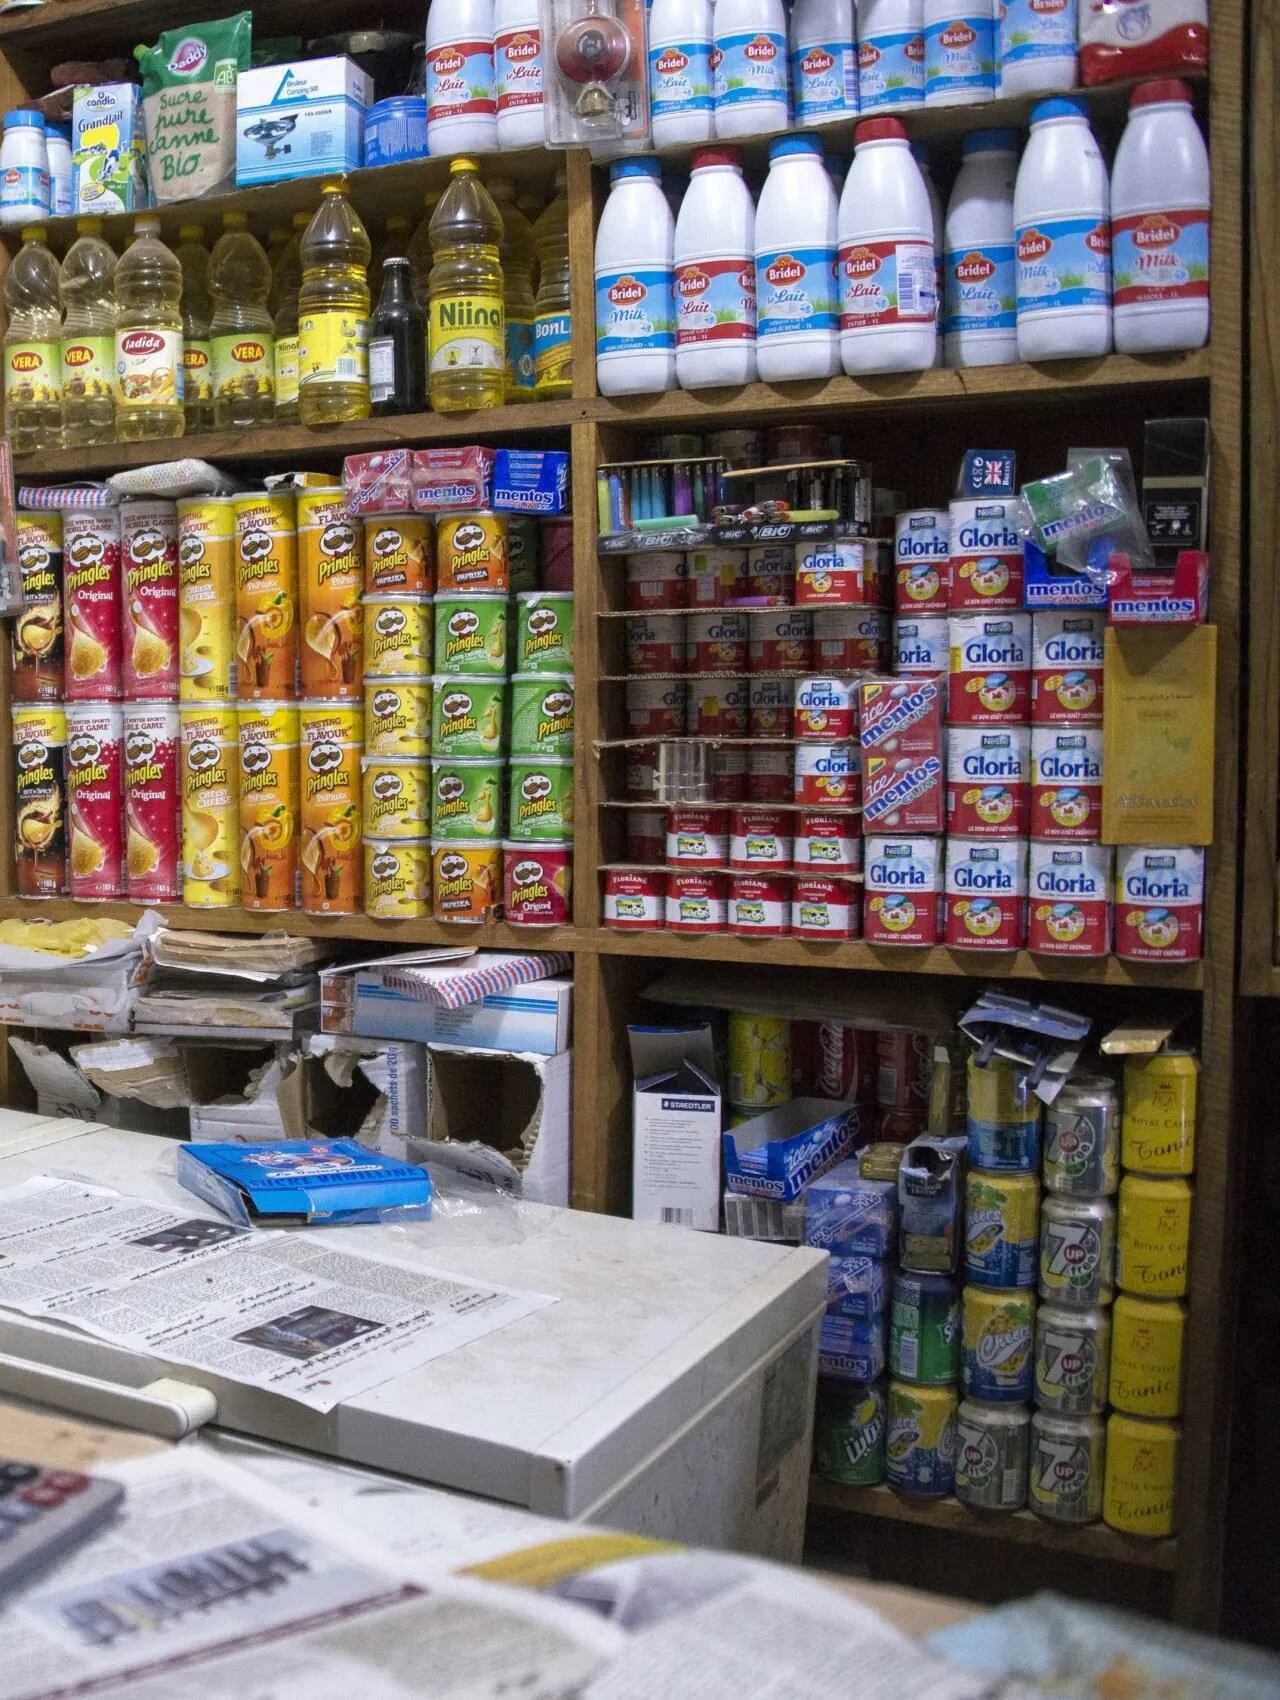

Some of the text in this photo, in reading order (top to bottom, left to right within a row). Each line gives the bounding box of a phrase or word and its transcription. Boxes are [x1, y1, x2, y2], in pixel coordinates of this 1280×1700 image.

[166, 43, 208, 73] Daddy
[508, 44, 538, 60] Bridel
[435, 57, 461, 73] Bridel
[658, 56, 686, 72] Bridel
[286, 85, 319, 96] Camping 500
[87, 96, 117, 108] candia
[160, 89, 207, 110] Sucre
[78, 110, 124, 132] Grandlait
[155, 107, 215, 138] pure
[150, 129, 220, 153] canne
[1136, 229, 1175, 244] Bridel
[846, 260, 876, 274] Bridel
[1135, 253, 1179, 269] Milk
[769, 267, 801, 281] Bridel
[957, 264, 991, 278] Bridel
[611, 287, 642, 301] Bridel
[774, 289, 806, 303] Lait
[849, 284, 881, 298] Lait
[961, 288, 995, 301] Lait
[440, 301, 504, 328] Niinal
[609, 310, 646, 323] Milk
[681, 303, 710, 314] Lait
[125, 336, 161, 352] Jadida
[65, 348, 91, 364] VERA
[233, 346, 265, 361] VERA
[13, 355, 41, 370] VERA
[417, 484, 476, 501] mentos
[495, 488, 554, 505] mentos
[762, 527, 789, 539] BIC
[804, 525, 824, 534] BIC
[644, 536, 673, 547] BIC
[959, 528, 1018, 549] Gloria
[897, 537, 949, 558] Gloria
[372, 552, 407, 574] Pringles
[452, 548, 490, 574] Pringles
[803, 554, 845, 569] Gloria
[376, 574, 406, 585] PAPRIKA
[456, 570, 488, 582] PAPRIKA
[78, 590, 113, 600] Original
[1027, 582, 1106, 597] mentos
[1113, 599, 1194, 614] mentos
[374, 632, 410, 656] Pringles
[446, 634, 484, 657] Pringles
[525, 632, 562, 657] Pringles
[966, 644, 1023, 664] Gloria
[800, 692, 841, 708] Gloria
[861, 683, 937, 748] mentos
[863, 699, 891, 726] ice
[371, 715, 406, 738] Pringles
[440, 715, 477, 738] Pringles
[982, 736, 1010, 747] Nestlé
[1057, 736, 1085, 748] Nestlé
[963, 756, 1022, 778] Gloria
[1040, 757, 1100, 779] Gloria
[187, 769, 226, 798] Pringles
[307, 770, 349, 801] Pringles
[866, 772, 896, 797] ice
[76, 789, 111, 800] Original
[132, 788, 166, 800] Original
[197, 796, 232, 808] CHEESE
[198, 789, 228, 800] CHEESY
[371, 797, 408, 822] Pringles
[435, 798, 469, 821] Pringles
[519, 798, 556, 820] Pringles
[885, 846, 911, 857] Nestlé
[971, 850, 998, 860] Nestlé
[1054, 853, 1081, 864] Nestlé
[870, 865, 925, 885] Gloria
[954, 868, 1012, 889] Gloria
[441, 900, 471, 909] PAPRIKA
[387, 1053, 399, 1067] 20
[390, 1067, 398, 1080] de
[390, 1080, 400, 1117] sachets
[670, 1103, 712, 1111] STAEDTLER
[1071, 1143, 1092, 1164] free
[729, 1174, 784, 1192] mentos
[1048, 1223, 1092, 1276] 7 UP
[1071, 1256, 1097, 1276] free
[1044, 1333, 1083, 1384] 7 UP
[1064, 1363, 1093, 1386] free
[1112, 1378, 1172, 1397] Tonic
[1038, 1442, 1076, 1491] 7 UP
